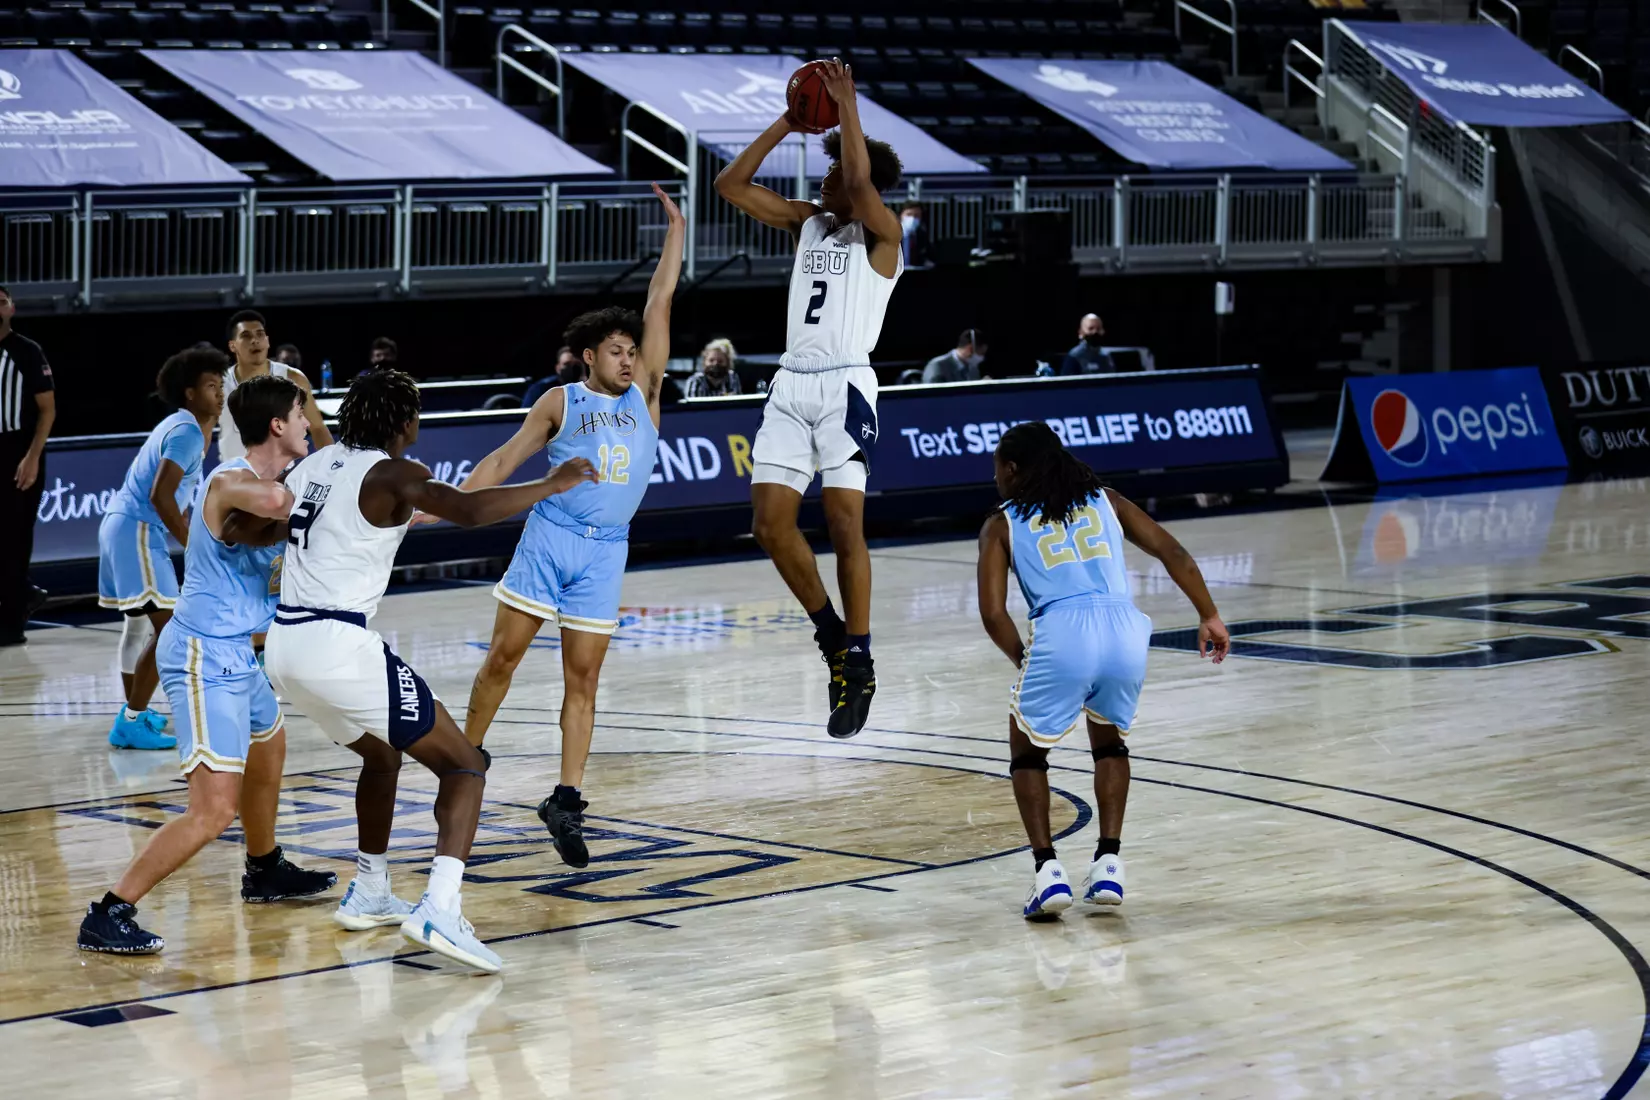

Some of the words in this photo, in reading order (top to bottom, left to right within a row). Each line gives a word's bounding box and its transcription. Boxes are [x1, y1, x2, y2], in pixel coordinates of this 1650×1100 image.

[802, 250, 848, 275] CBU
[804, 280, 828, 325] 2
[901, 427, 962, 459] Text
[1045, 413, 1140, 447] RELIEF
[1144, 412, 1172, 441] to
[1174, 405, 1253, 439] 888111
[1432, 393, 1539, 455] pepsi
[1602, 428, 1649, 450] BUICK
[598, 444, 630, 485] 12
[1028, 505, 1112, 571] 22
[396, 665, 420, 721] LANCERS
